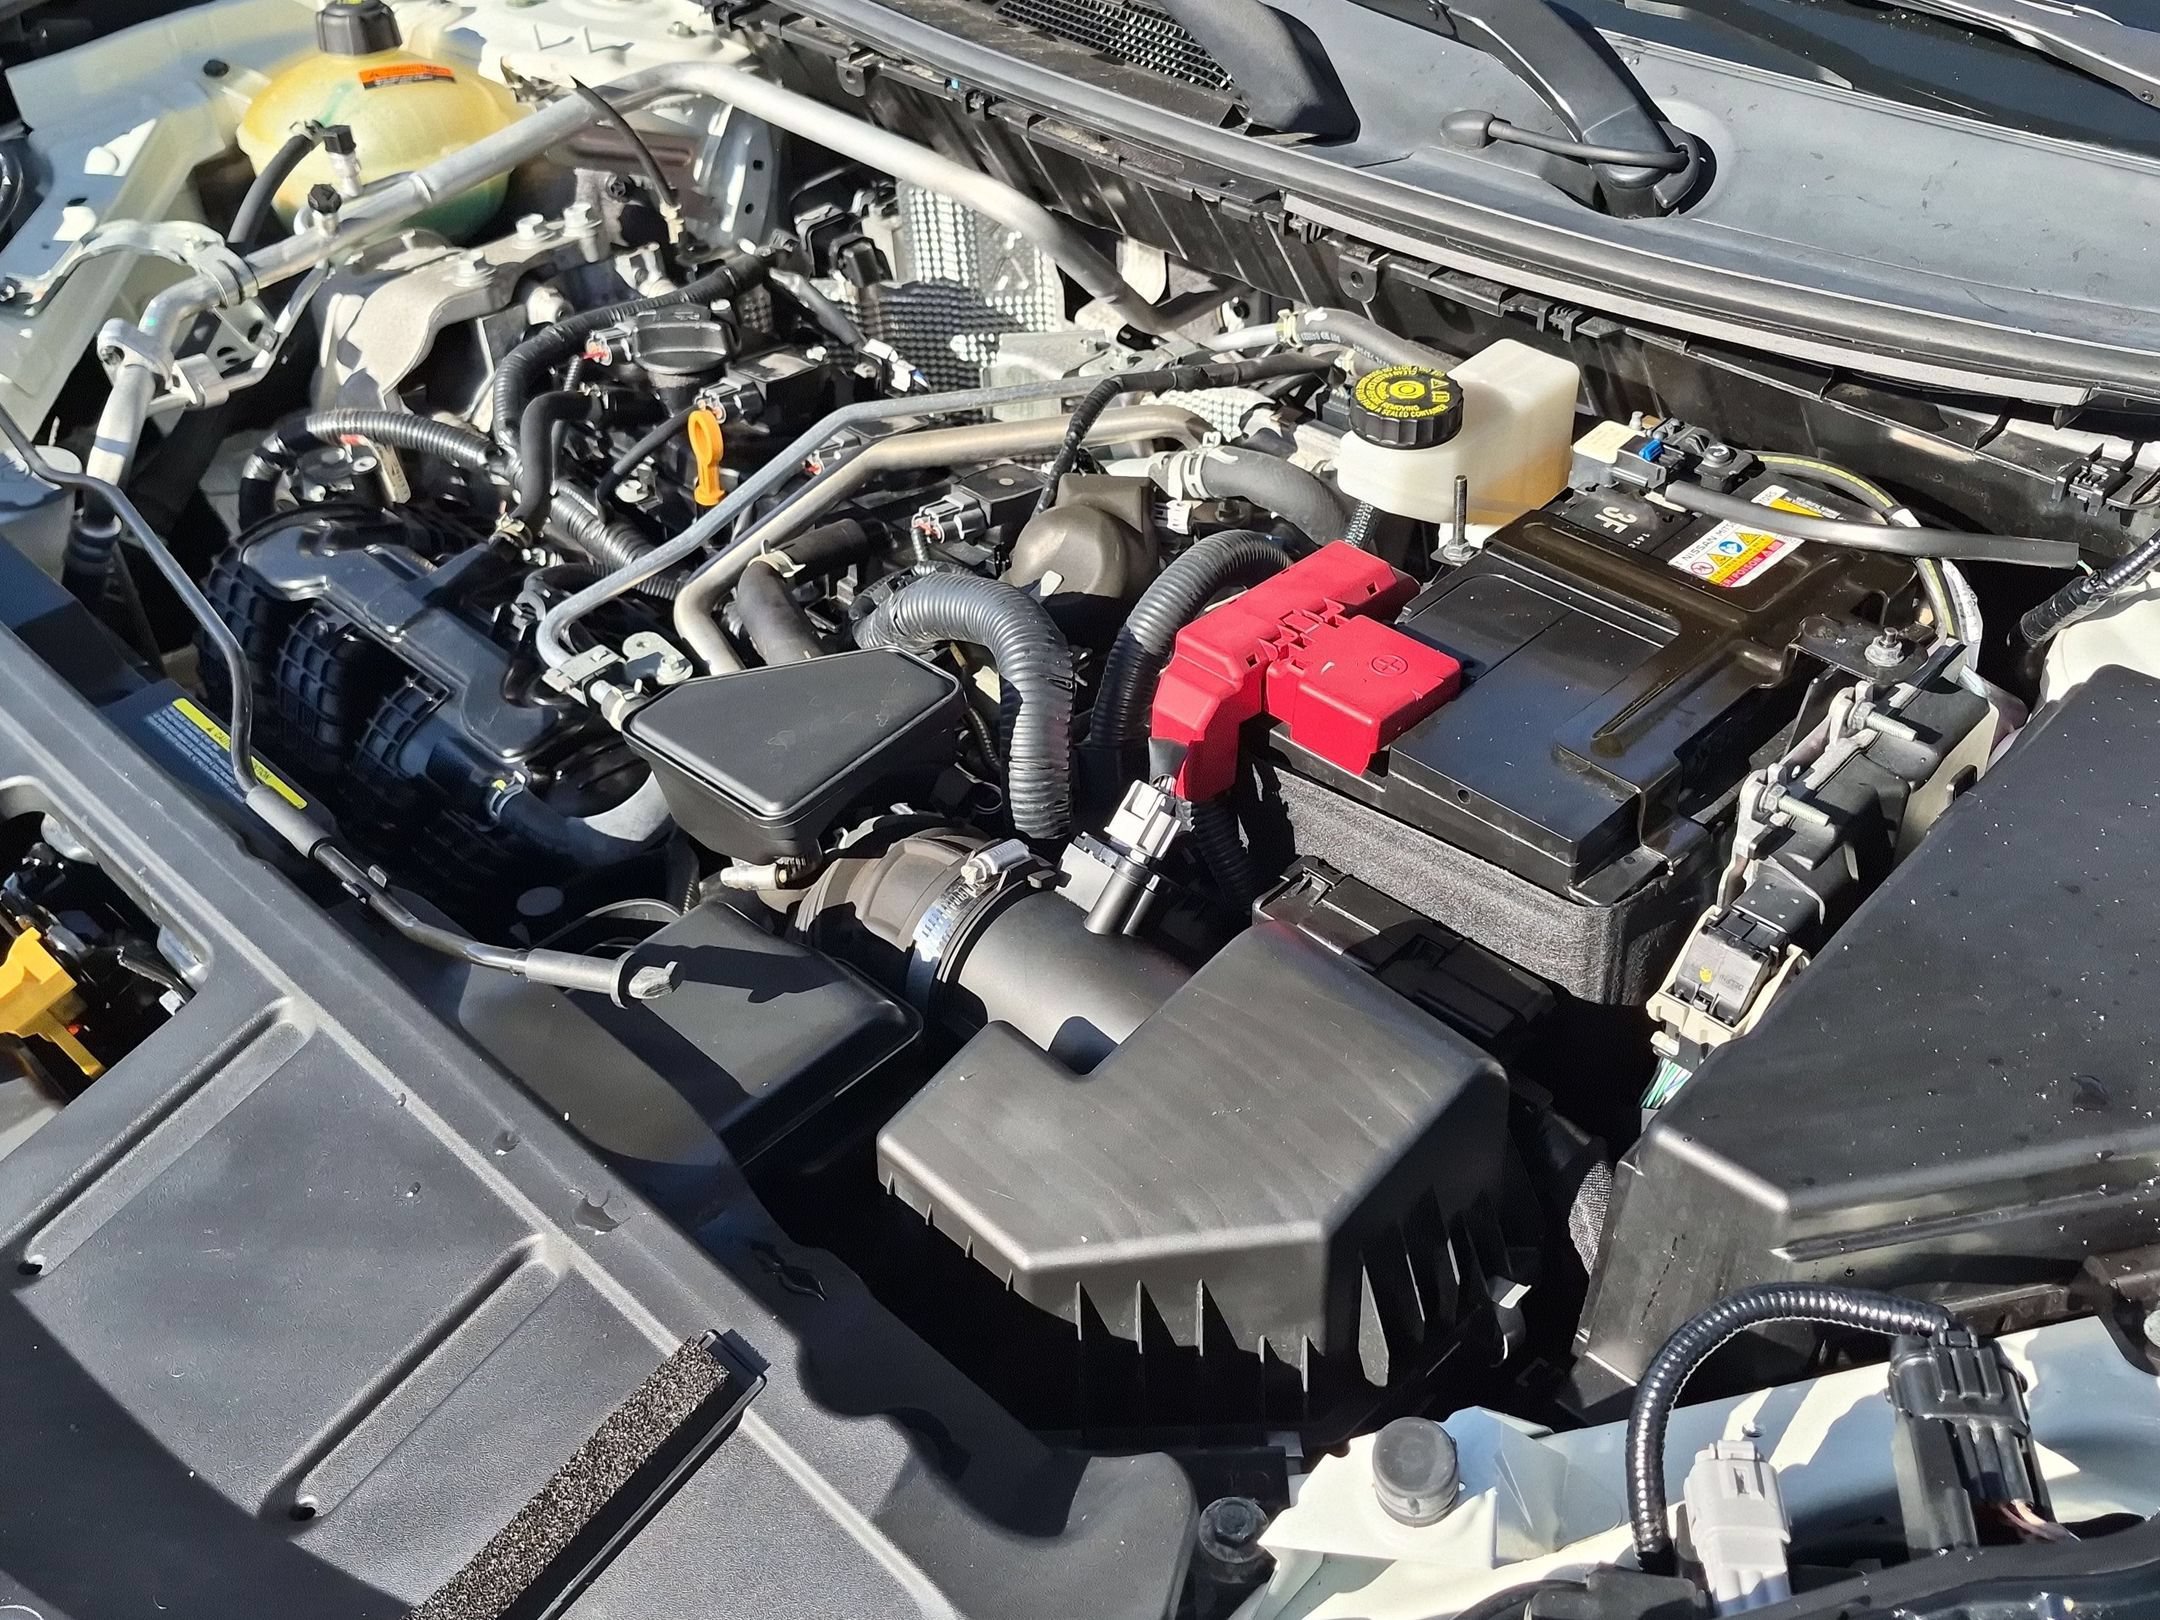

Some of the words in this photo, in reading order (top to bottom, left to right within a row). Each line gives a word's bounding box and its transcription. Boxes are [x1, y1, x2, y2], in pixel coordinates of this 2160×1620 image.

[1380, 402, 1421, 412] REMOVING
[1381, 408, 1411, 418] SEALED
[1410, 403, 1449, 418] CONTAINER
[1681, 535, 1718, 562] NISSAN
